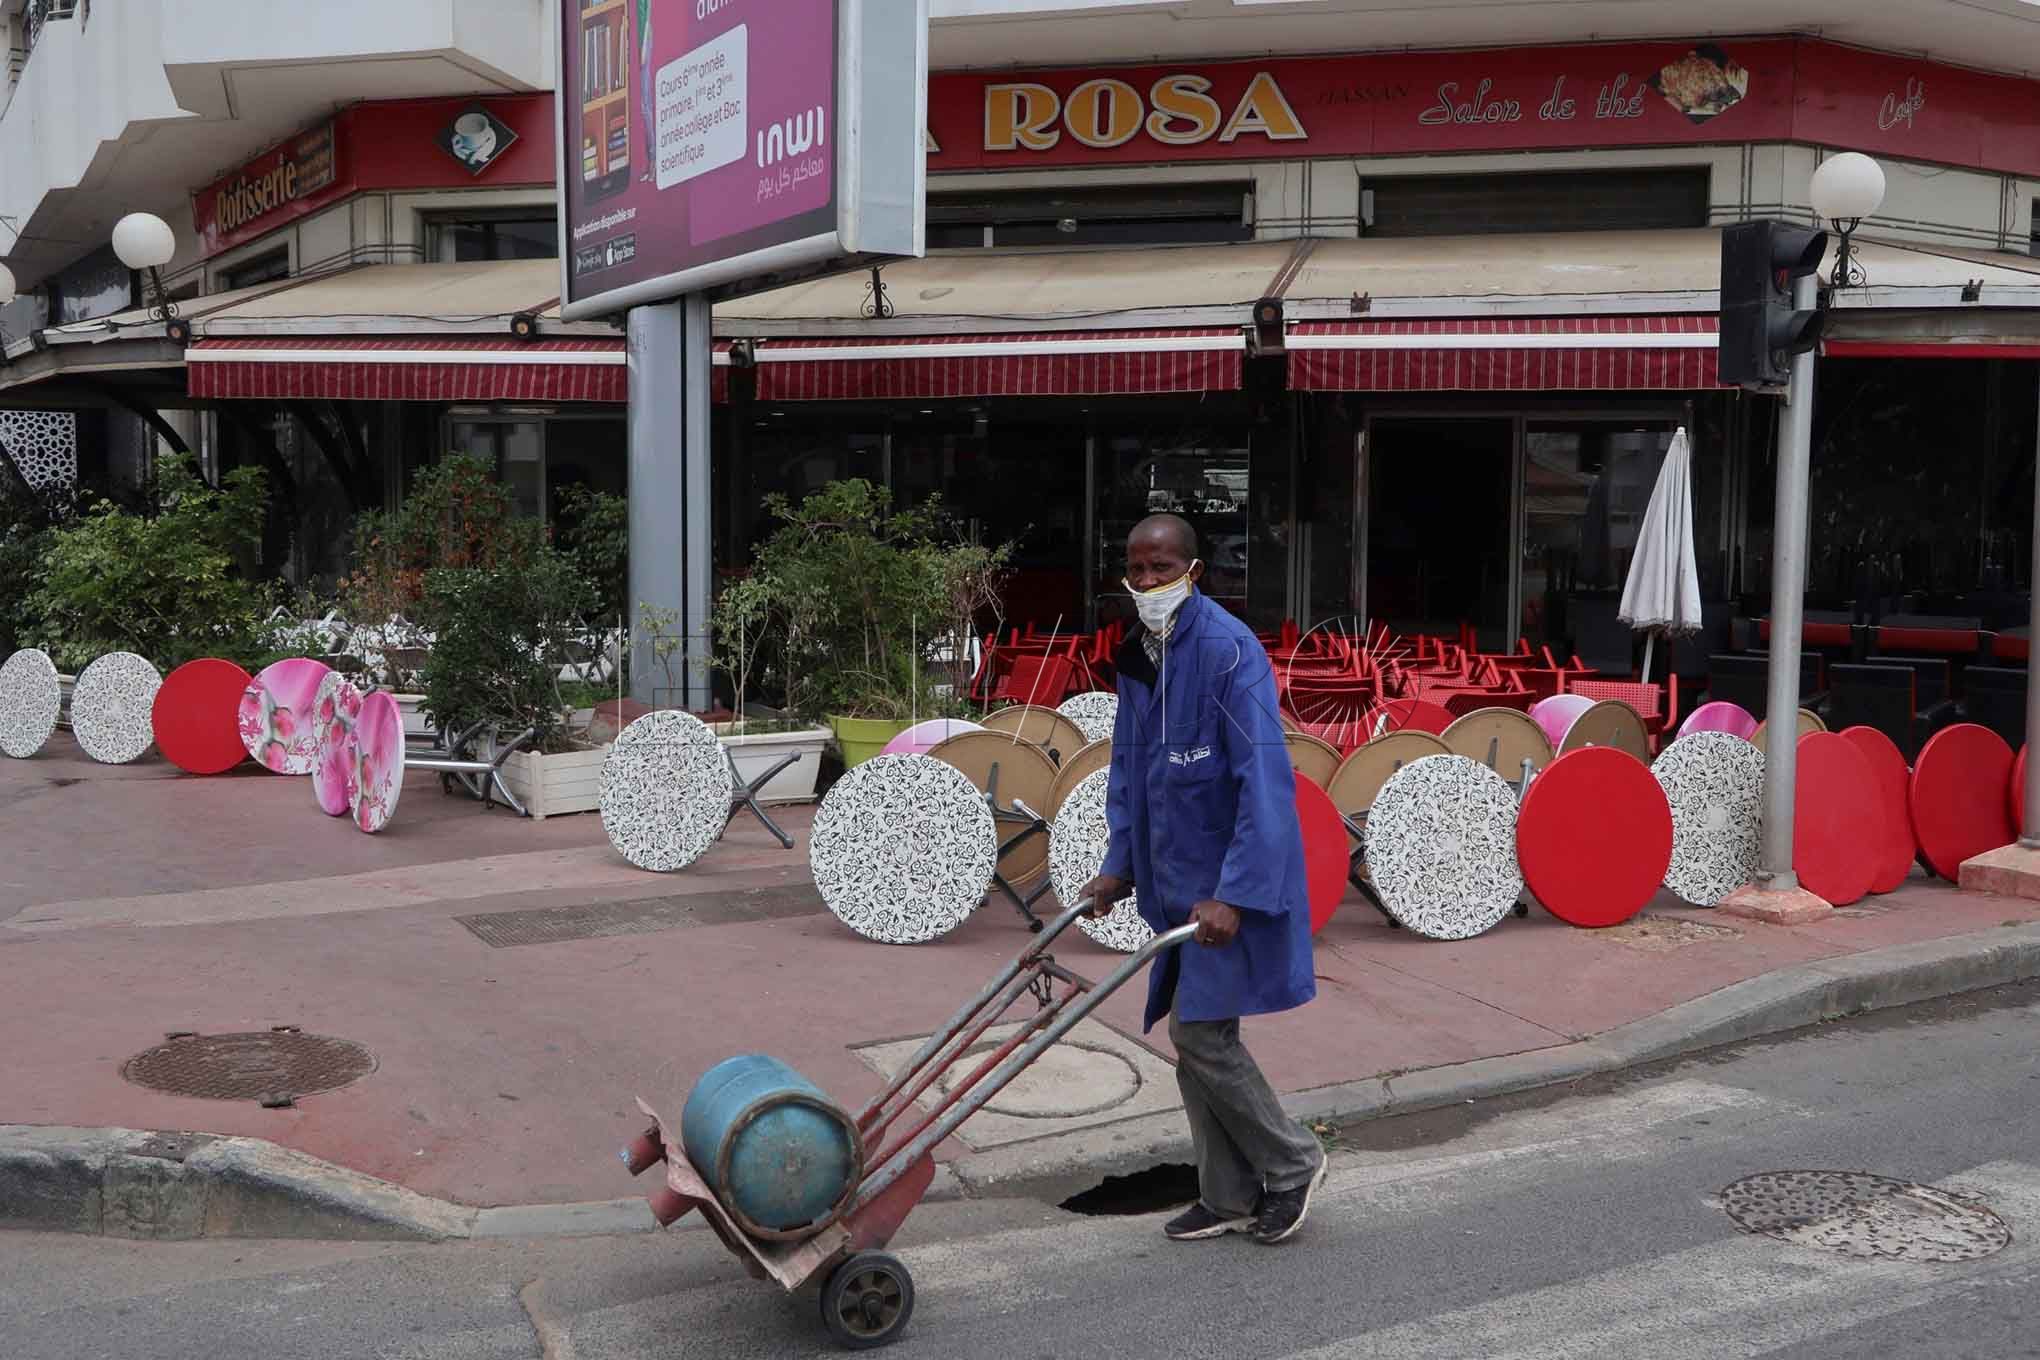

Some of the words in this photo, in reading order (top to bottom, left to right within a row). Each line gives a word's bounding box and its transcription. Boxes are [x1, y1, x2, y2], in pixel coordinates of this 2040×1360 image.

[660, 74, 683, 98] Cours
[699, 52, 726, 78] année
[1418, 79, 1522, 125] Salon
[1538, 76, 1576, 120] de
[1595, 74, 1648, 118] thé
[660, 123, 684, 148] année
[723, 100, 741, 120] Bac
[984, 71, 1308, 152] ROSA
[1878, 77, 1926, 130] Café
[660, 143, 705, 173] scientifique
